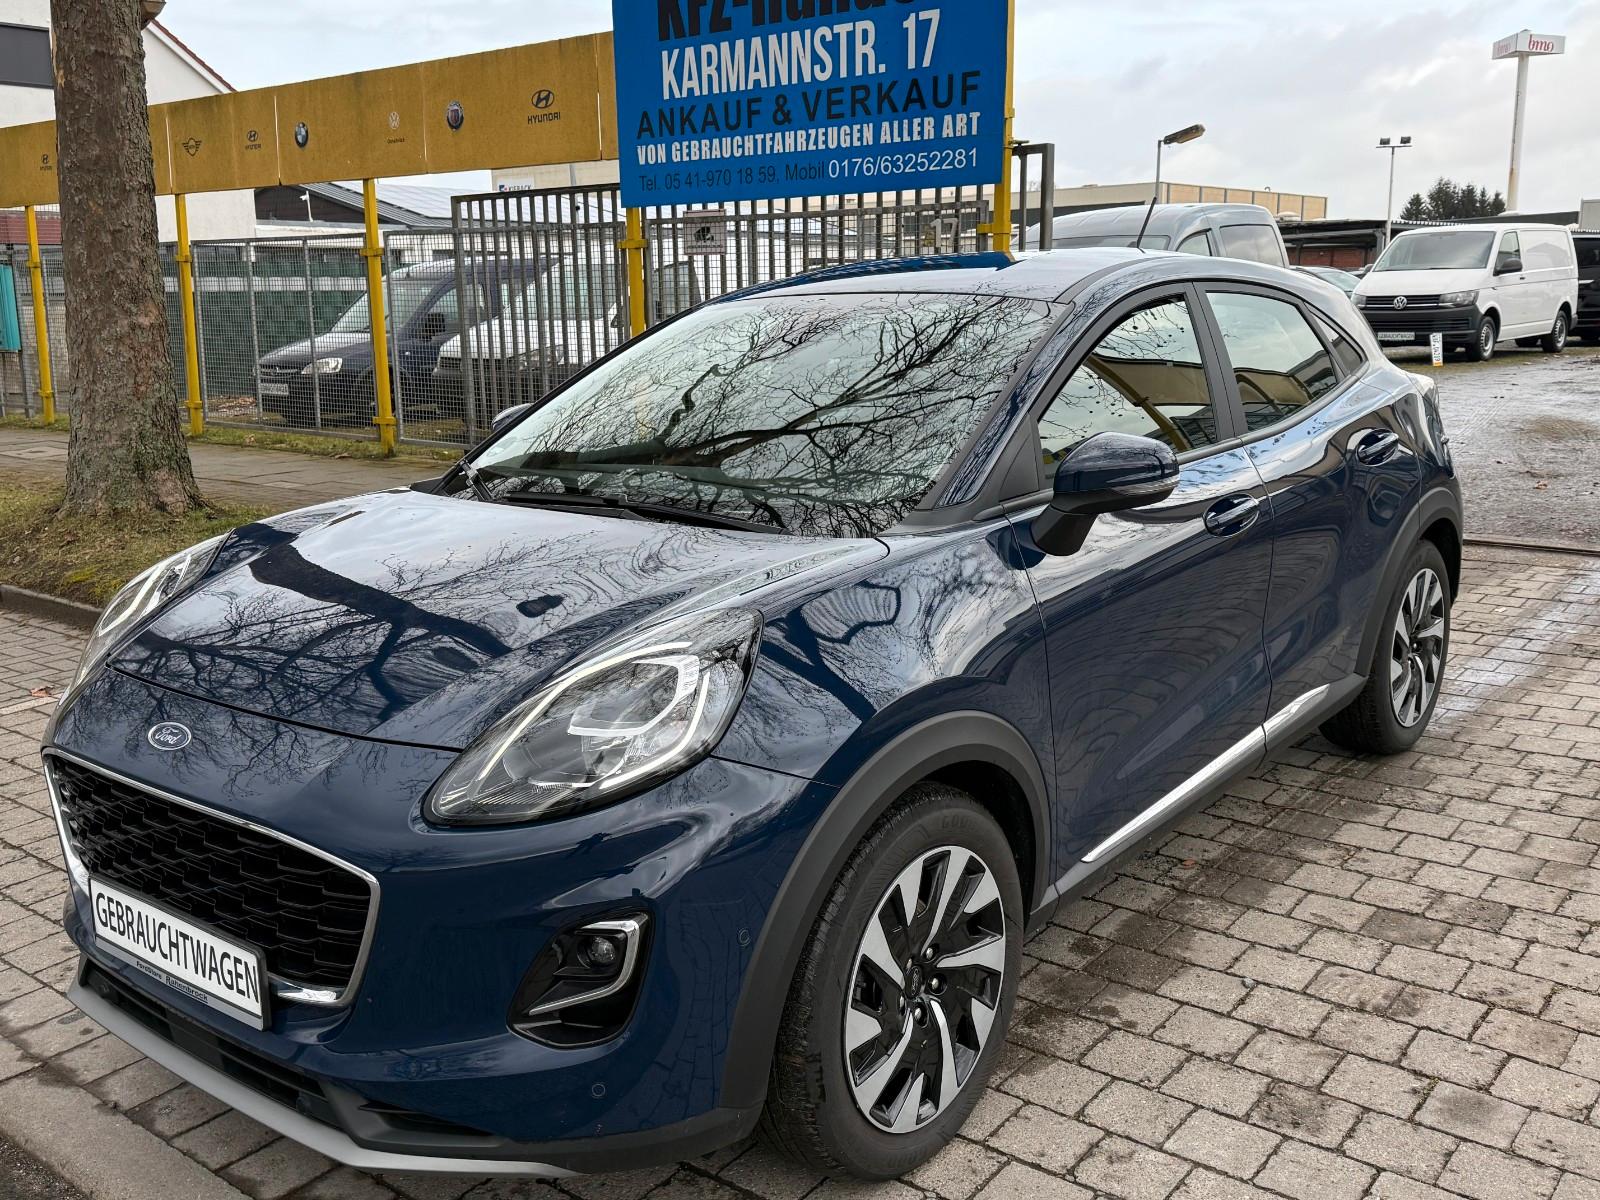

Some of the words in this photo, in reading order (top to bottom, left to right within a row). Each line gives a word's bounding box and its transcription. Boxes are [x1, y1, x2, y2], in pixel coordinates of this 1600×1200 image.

[661, 19, 886, 100] KARMANNSTR.
[903, 8, 940, 70] 17
[527, 111, 561, 125] HYUNDAI
[637, 97, 762, 139] ANKAUF
[772, 94, 792, 126] &
[802, 70, 981, 122] VERKAUF
[637, 143, 667, 166] VON
[671, 123, 874, 163] GEBRAUCHTFAHRZEUGEN
[880, 116, 935, 144] ALLER
[942, 111, 981, 138] ART
[639, 175, 661, 192] Tel.
[664, 173, 681, 190] 05
[684, 168, 732, 189] 41-970
[737, 167, 753, 185] 18
[785, 161, 825, 181] Mobil
[828, 147, 977, 178] 0176/63252281
[930, 217, 959, 249] 17
[153, 725, 184, 746] Ford
[95, 892, 260, 1004] GEBRAUCHTWAGEN
